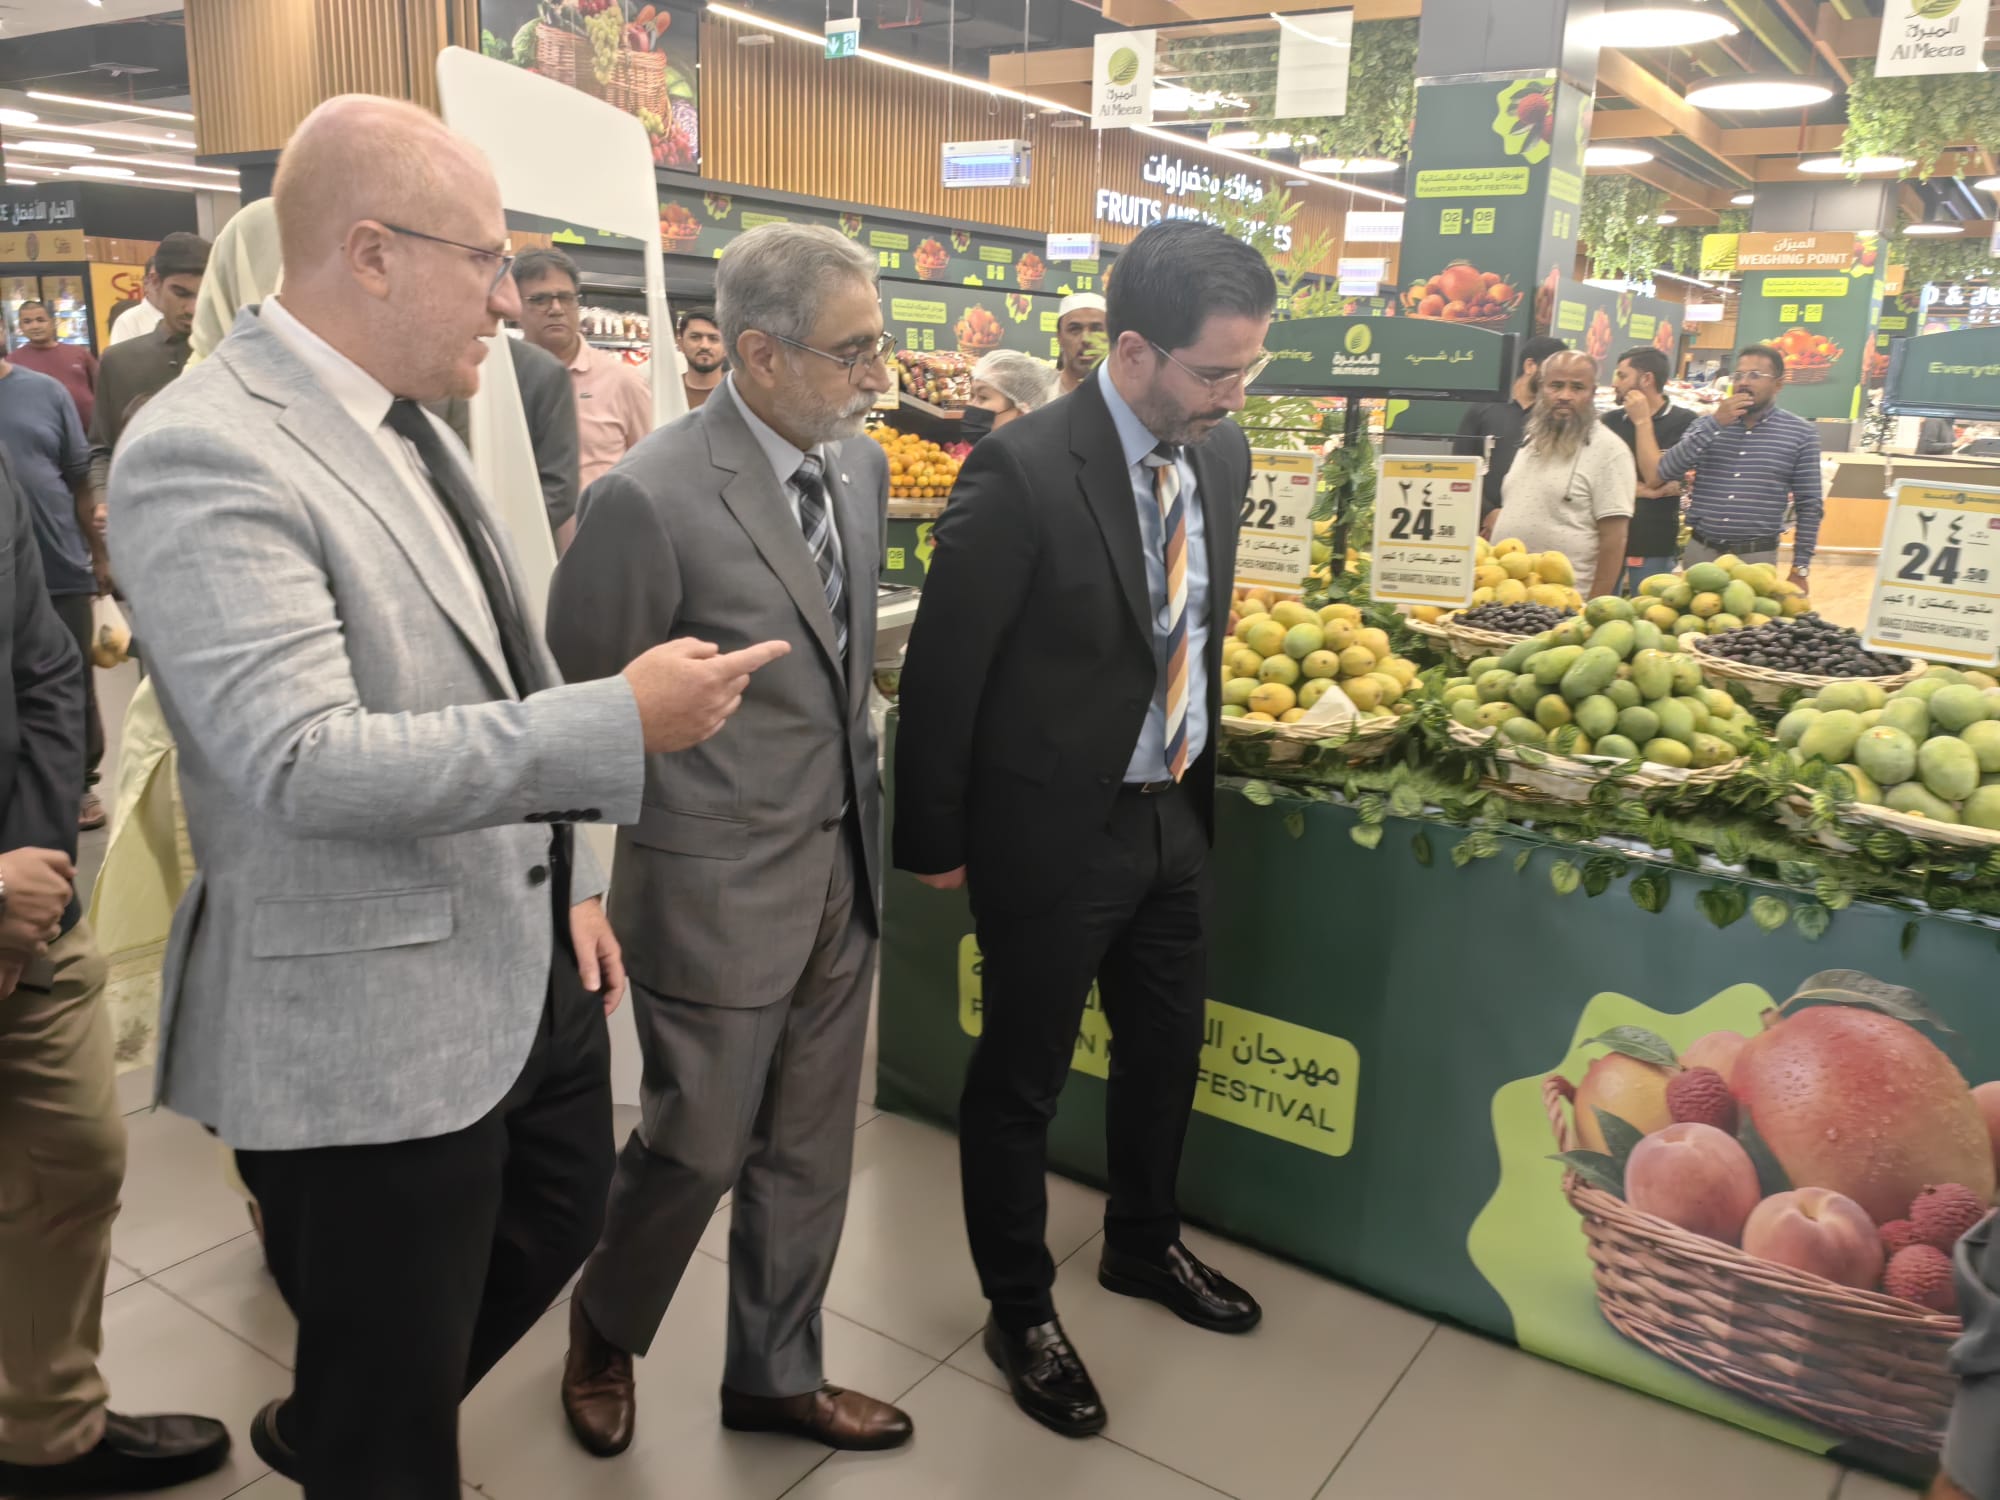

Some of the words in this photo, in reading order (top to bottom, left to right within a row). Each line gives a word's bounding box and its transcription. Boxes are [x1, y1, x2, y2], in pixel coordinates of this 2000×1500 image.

[1890, 44, 1911, 60] Al
[1912, 43, 1966, 58] Meera
[1099, 104, 1111, 117] Al
[1112, 103, 1143, 116] Meera
[1096, 189, 1163, 228] FRUITS
[1443, 212, 1462, 223] 02
[1739, 253, 1804, 266] WEIGHING
[1805, 252, 1849, 264] POINT
[1390, 507, 1435, 541] 24
[1897, 542, 1961, 585] 24
[1231, 1032, 1341, 1088] مهرجان
